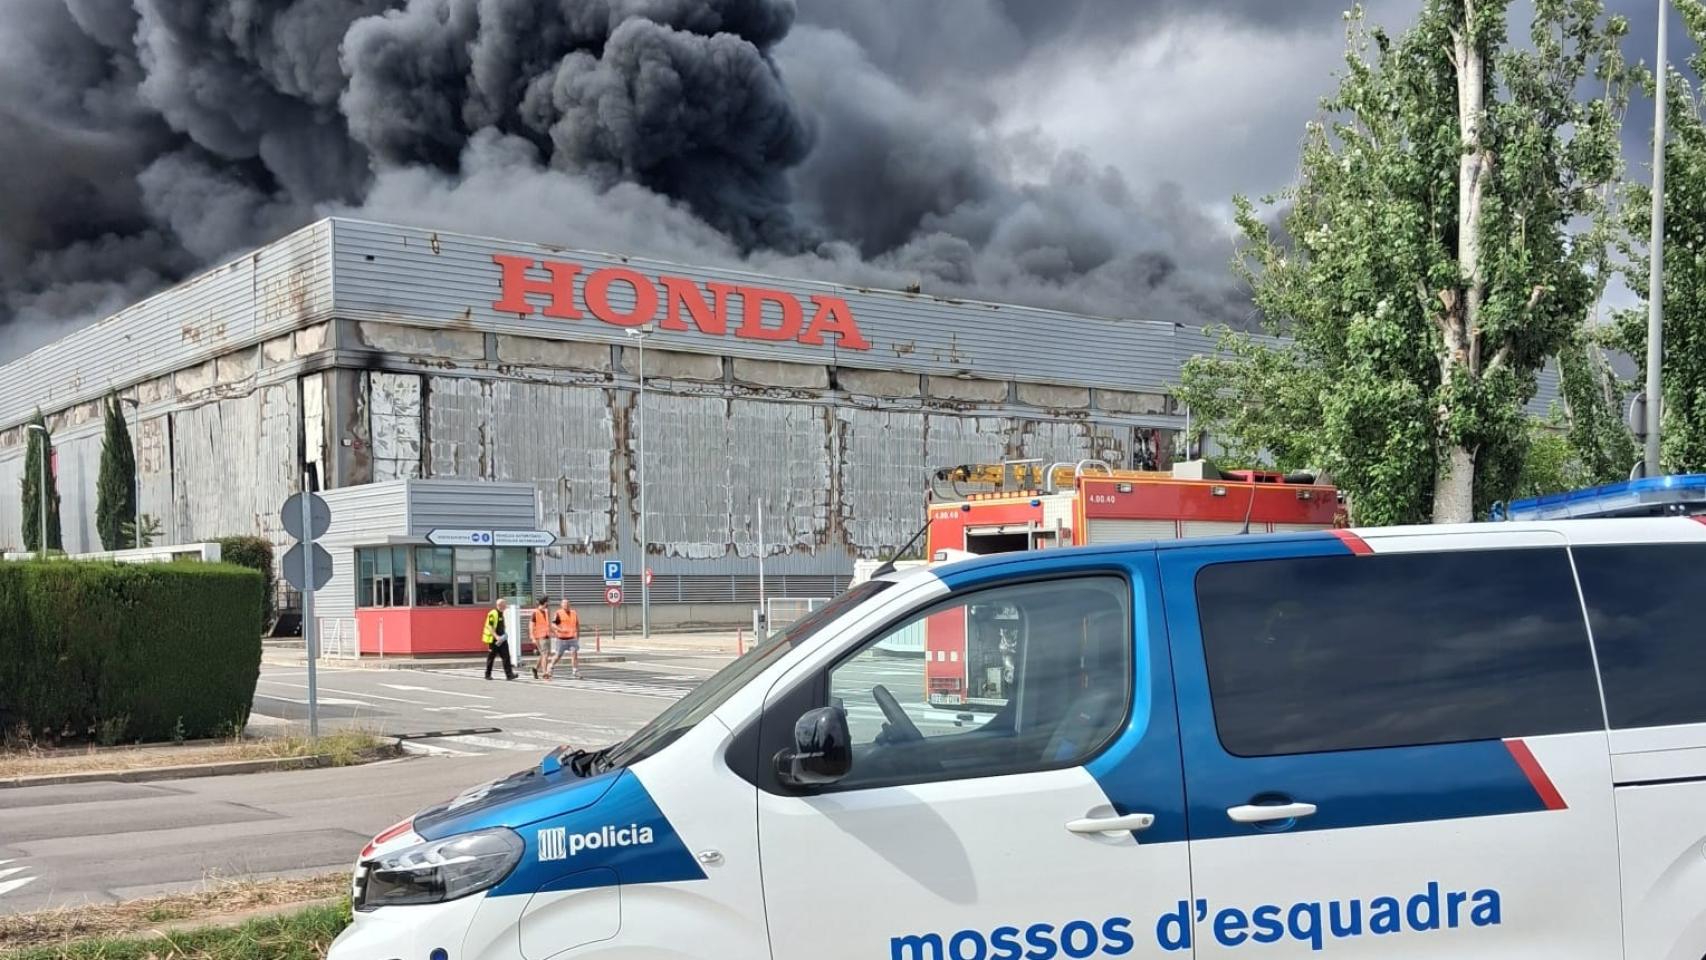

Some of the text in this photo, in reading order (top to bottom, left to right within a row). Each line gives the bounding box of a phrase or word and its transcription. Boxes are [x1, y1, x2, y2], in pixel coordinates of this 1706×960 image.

[492, 254, 871, 350] HONDA
[1089, 494, 1116, 505] 4.00.40
[608, 563, 619, 577] P
[608, 592, 619, 600] 30
[569, 823, 654, 856] policia
[890, 916, 1134, 960] mossos
